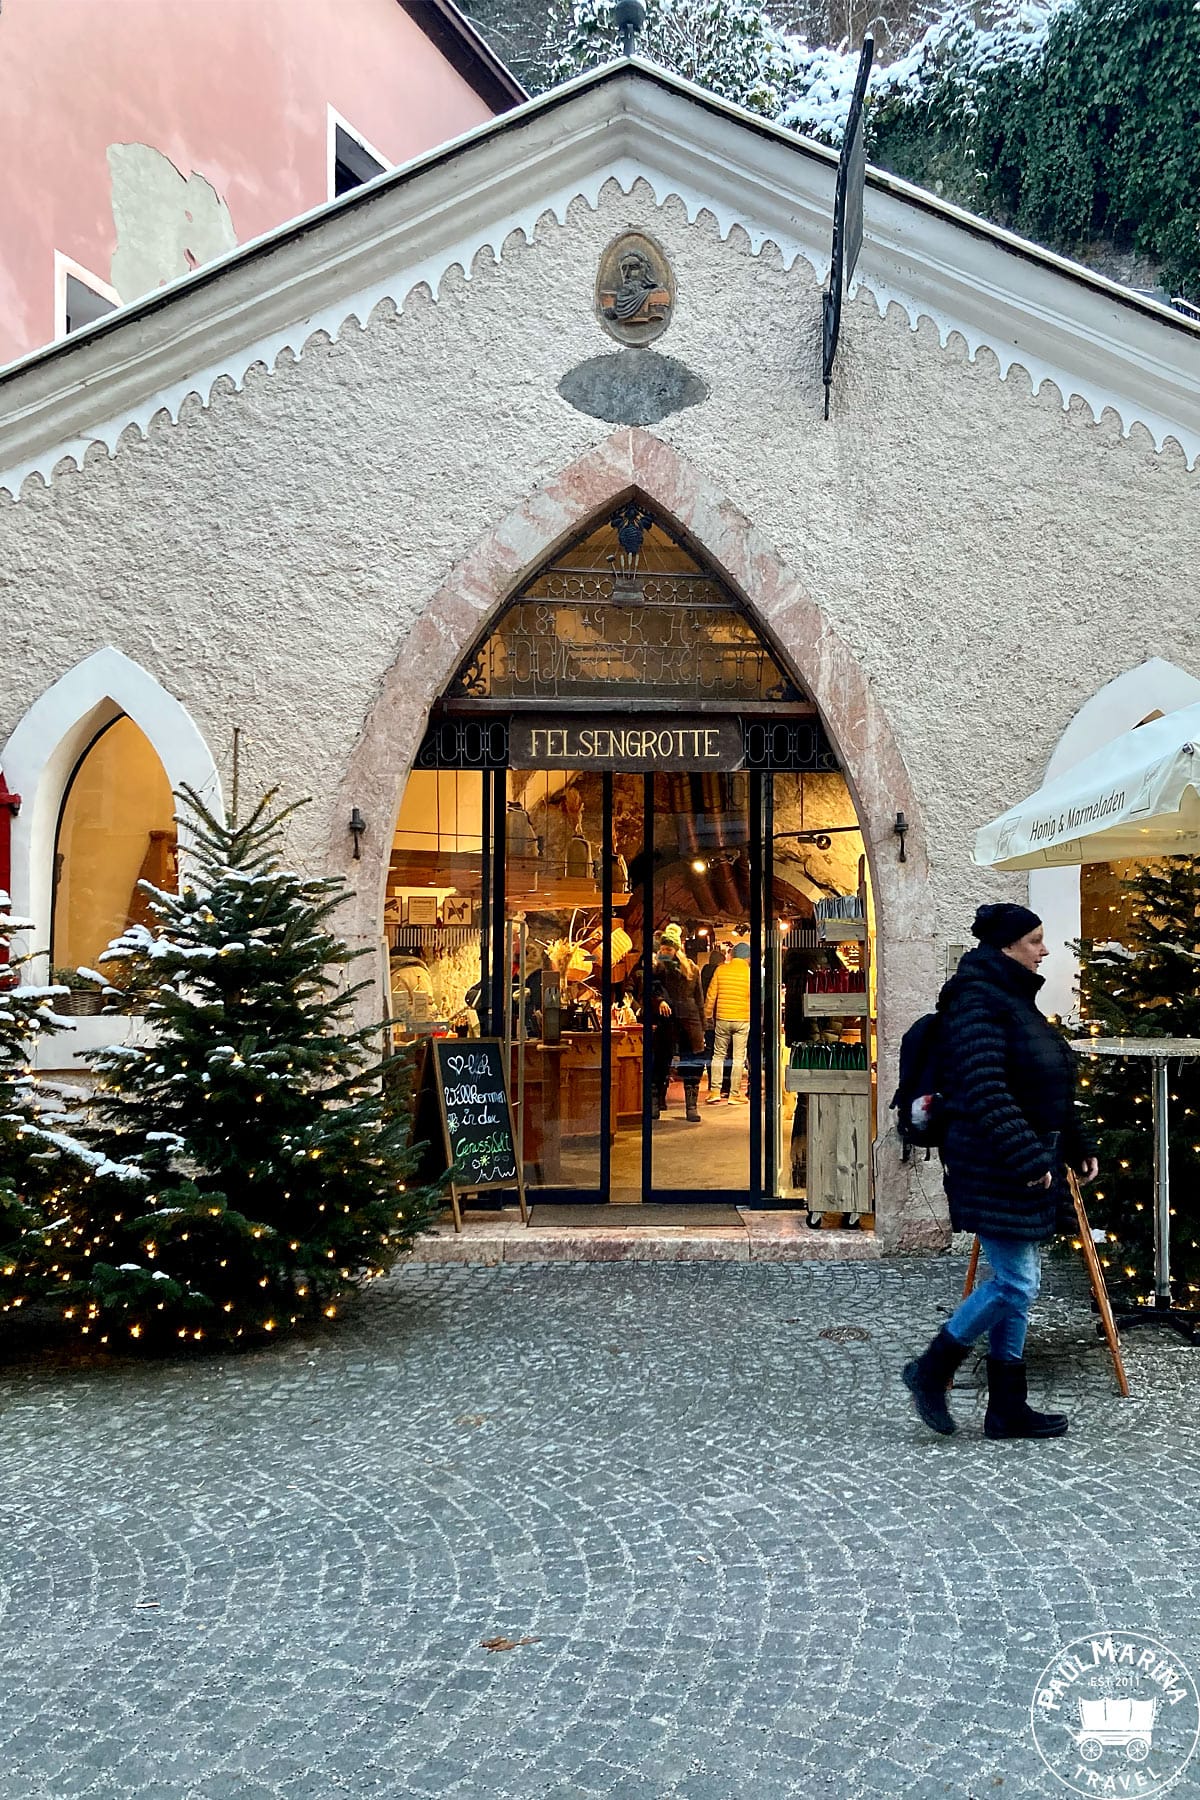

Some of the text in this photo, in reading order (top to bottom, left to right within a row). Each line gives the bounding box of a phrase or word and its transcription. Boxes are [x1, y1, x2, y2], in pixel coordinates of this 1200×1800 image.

[530, 728, 720, 758] FELSENGROTTE
[1029, 816, 1056, 842] Honig
[1058, 813, 1065, 833] &
[1066, 789, 1125, 830] Marmeladen
[462, 1105, 501, 1125] in der
